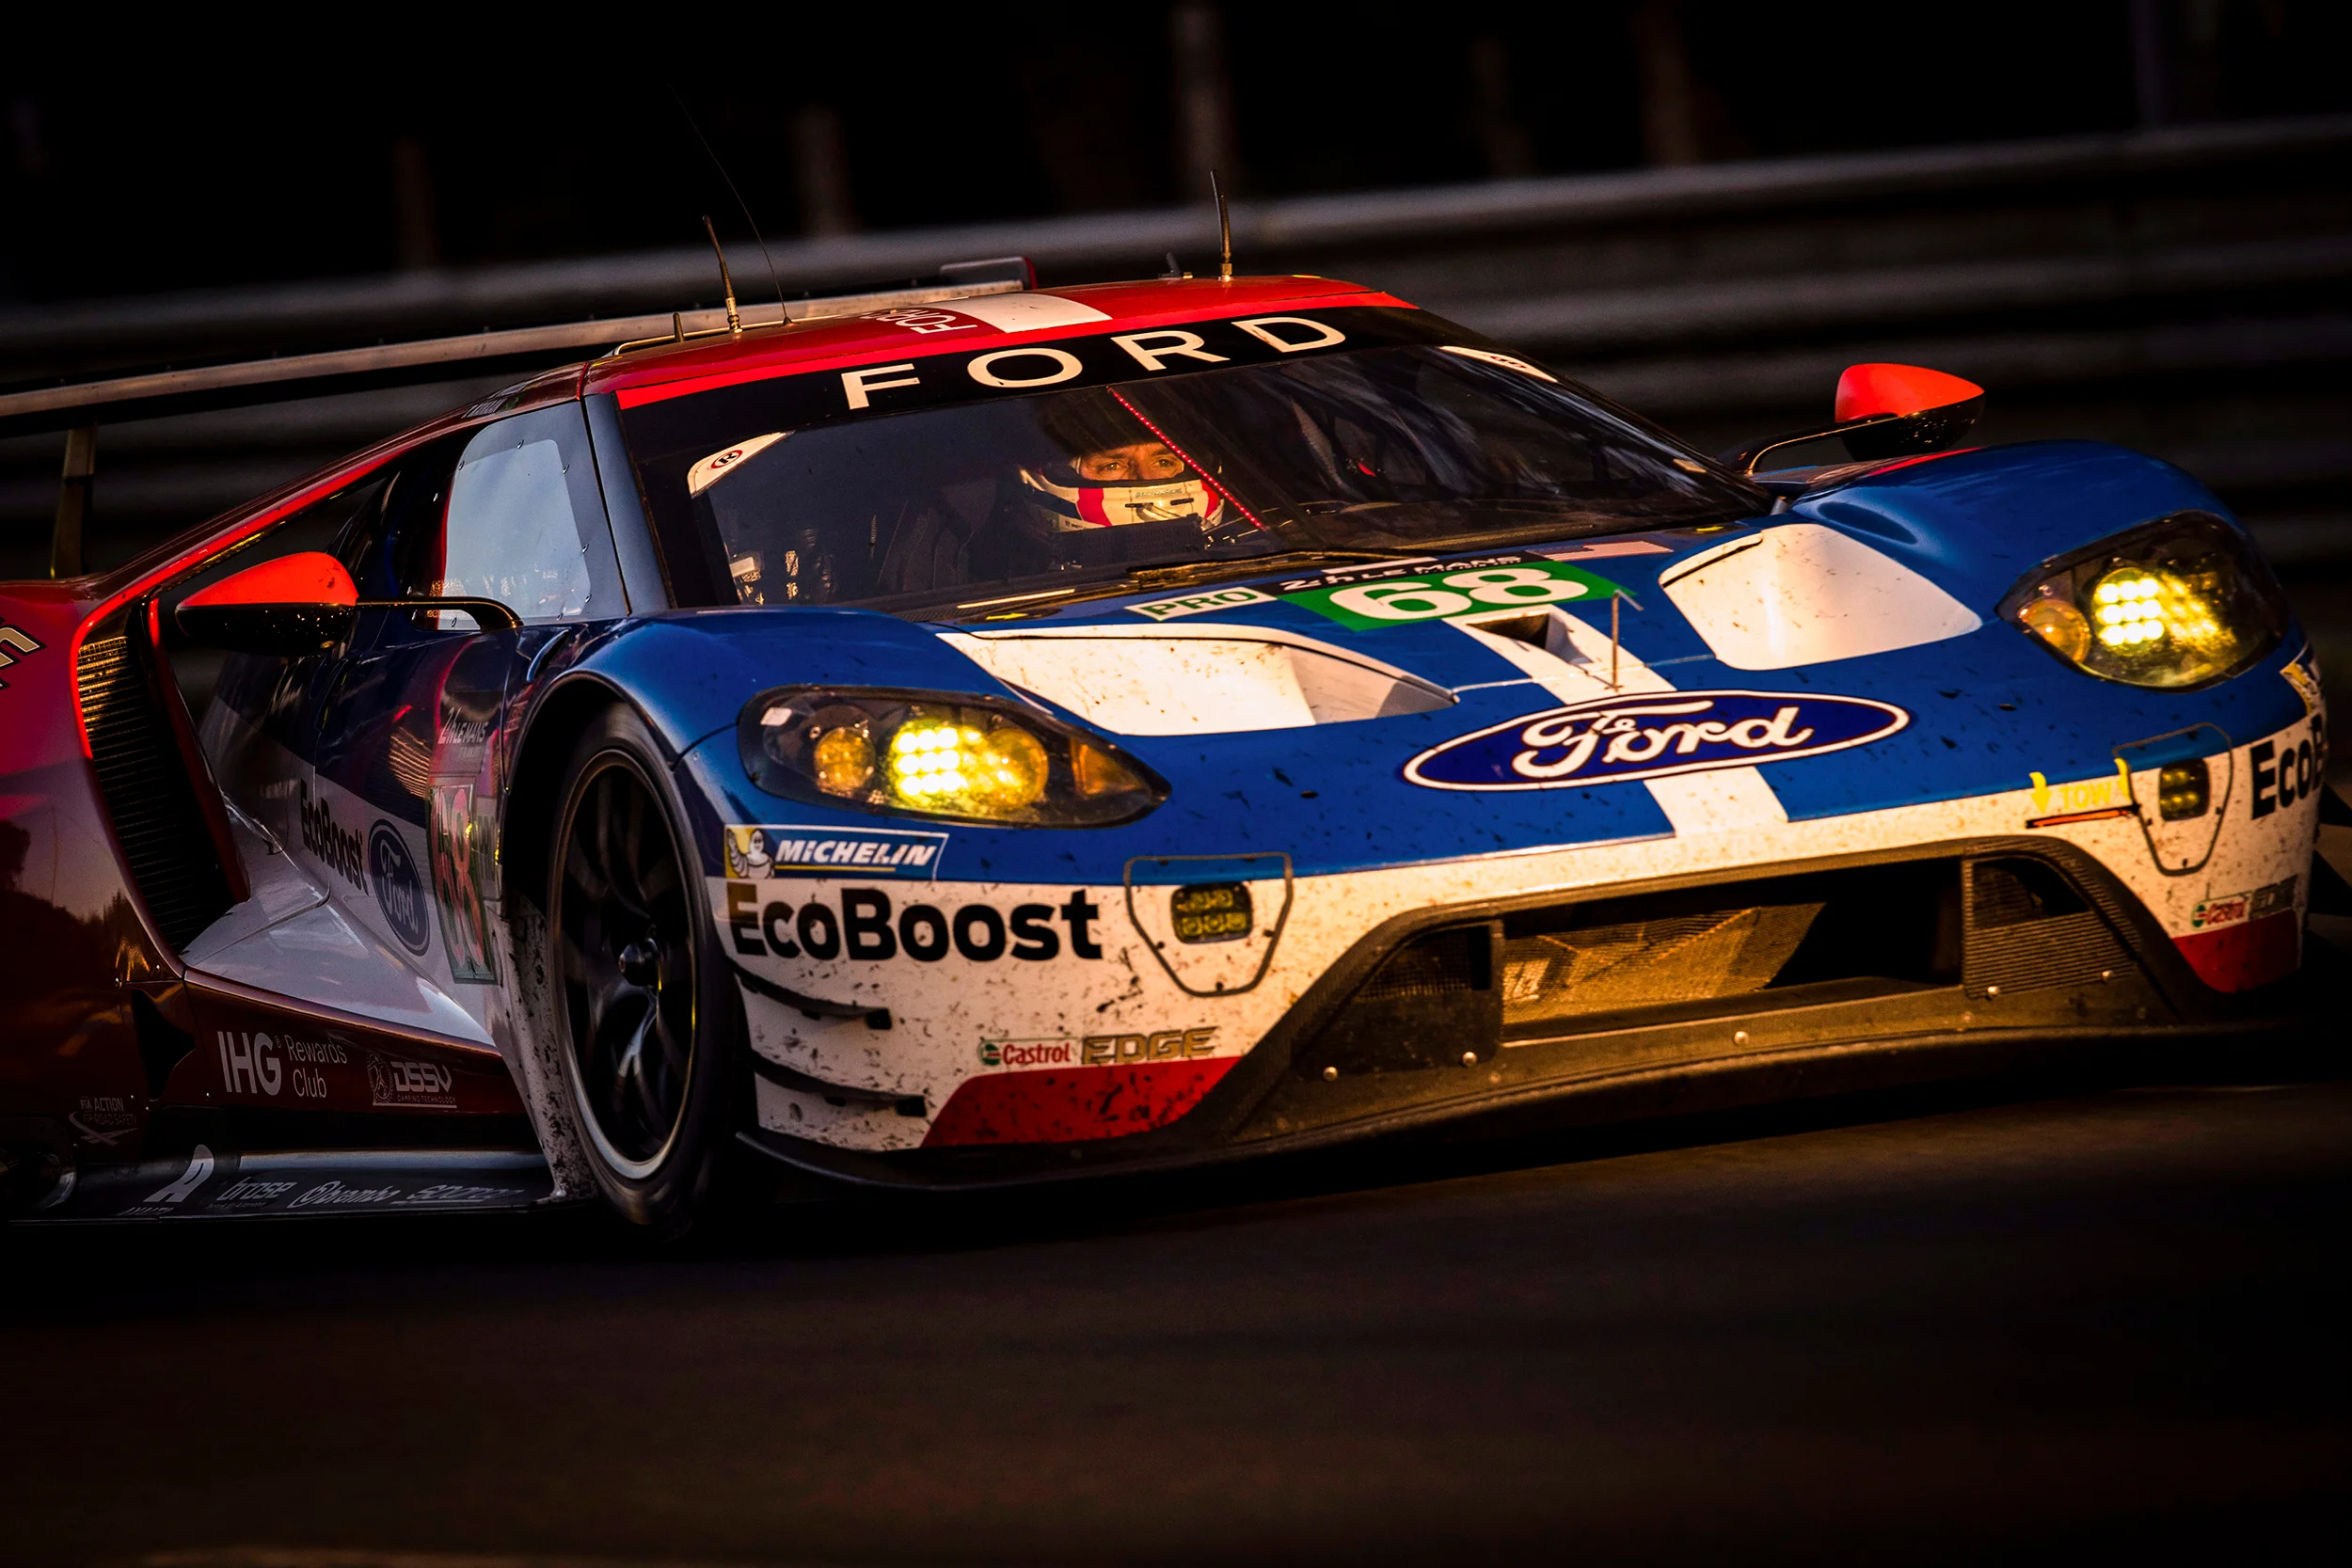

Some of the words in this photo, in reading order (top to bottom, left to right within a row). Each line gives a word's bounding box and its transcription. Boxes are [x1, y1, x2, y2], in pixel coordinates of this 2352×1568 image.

[840, 317, 1346, 409] FORD
[1361, 568, 1406, 579] LE
[1414, 556, 1521, 575] MANS
[1139, 591, 1259, 615] PRO
[1328, 567, 1589, 620] 68
[1511, 700, 1815, 779] Ford
[2058, 781, 2112, 810] TOW
[300, 778, 370, 896] EcoBoost
[774, 840, 937, 866] MICHELIN
[379, 839, 420, 935] Ford
[727, 881, 1102, 960] EcoBoost
[284, 1034, 347, 1064] Rewards
[1003, 1043, 1072, 1065] Castrol
[1083, 1025, 1220, 1066] EDGE
[293, 1068, 327, 1099] Club
[390, 1061, 453, 1093] DSSV
[94, 1097, 124, 1112] ACTION
[215, 1176, 298, 1201] brose
